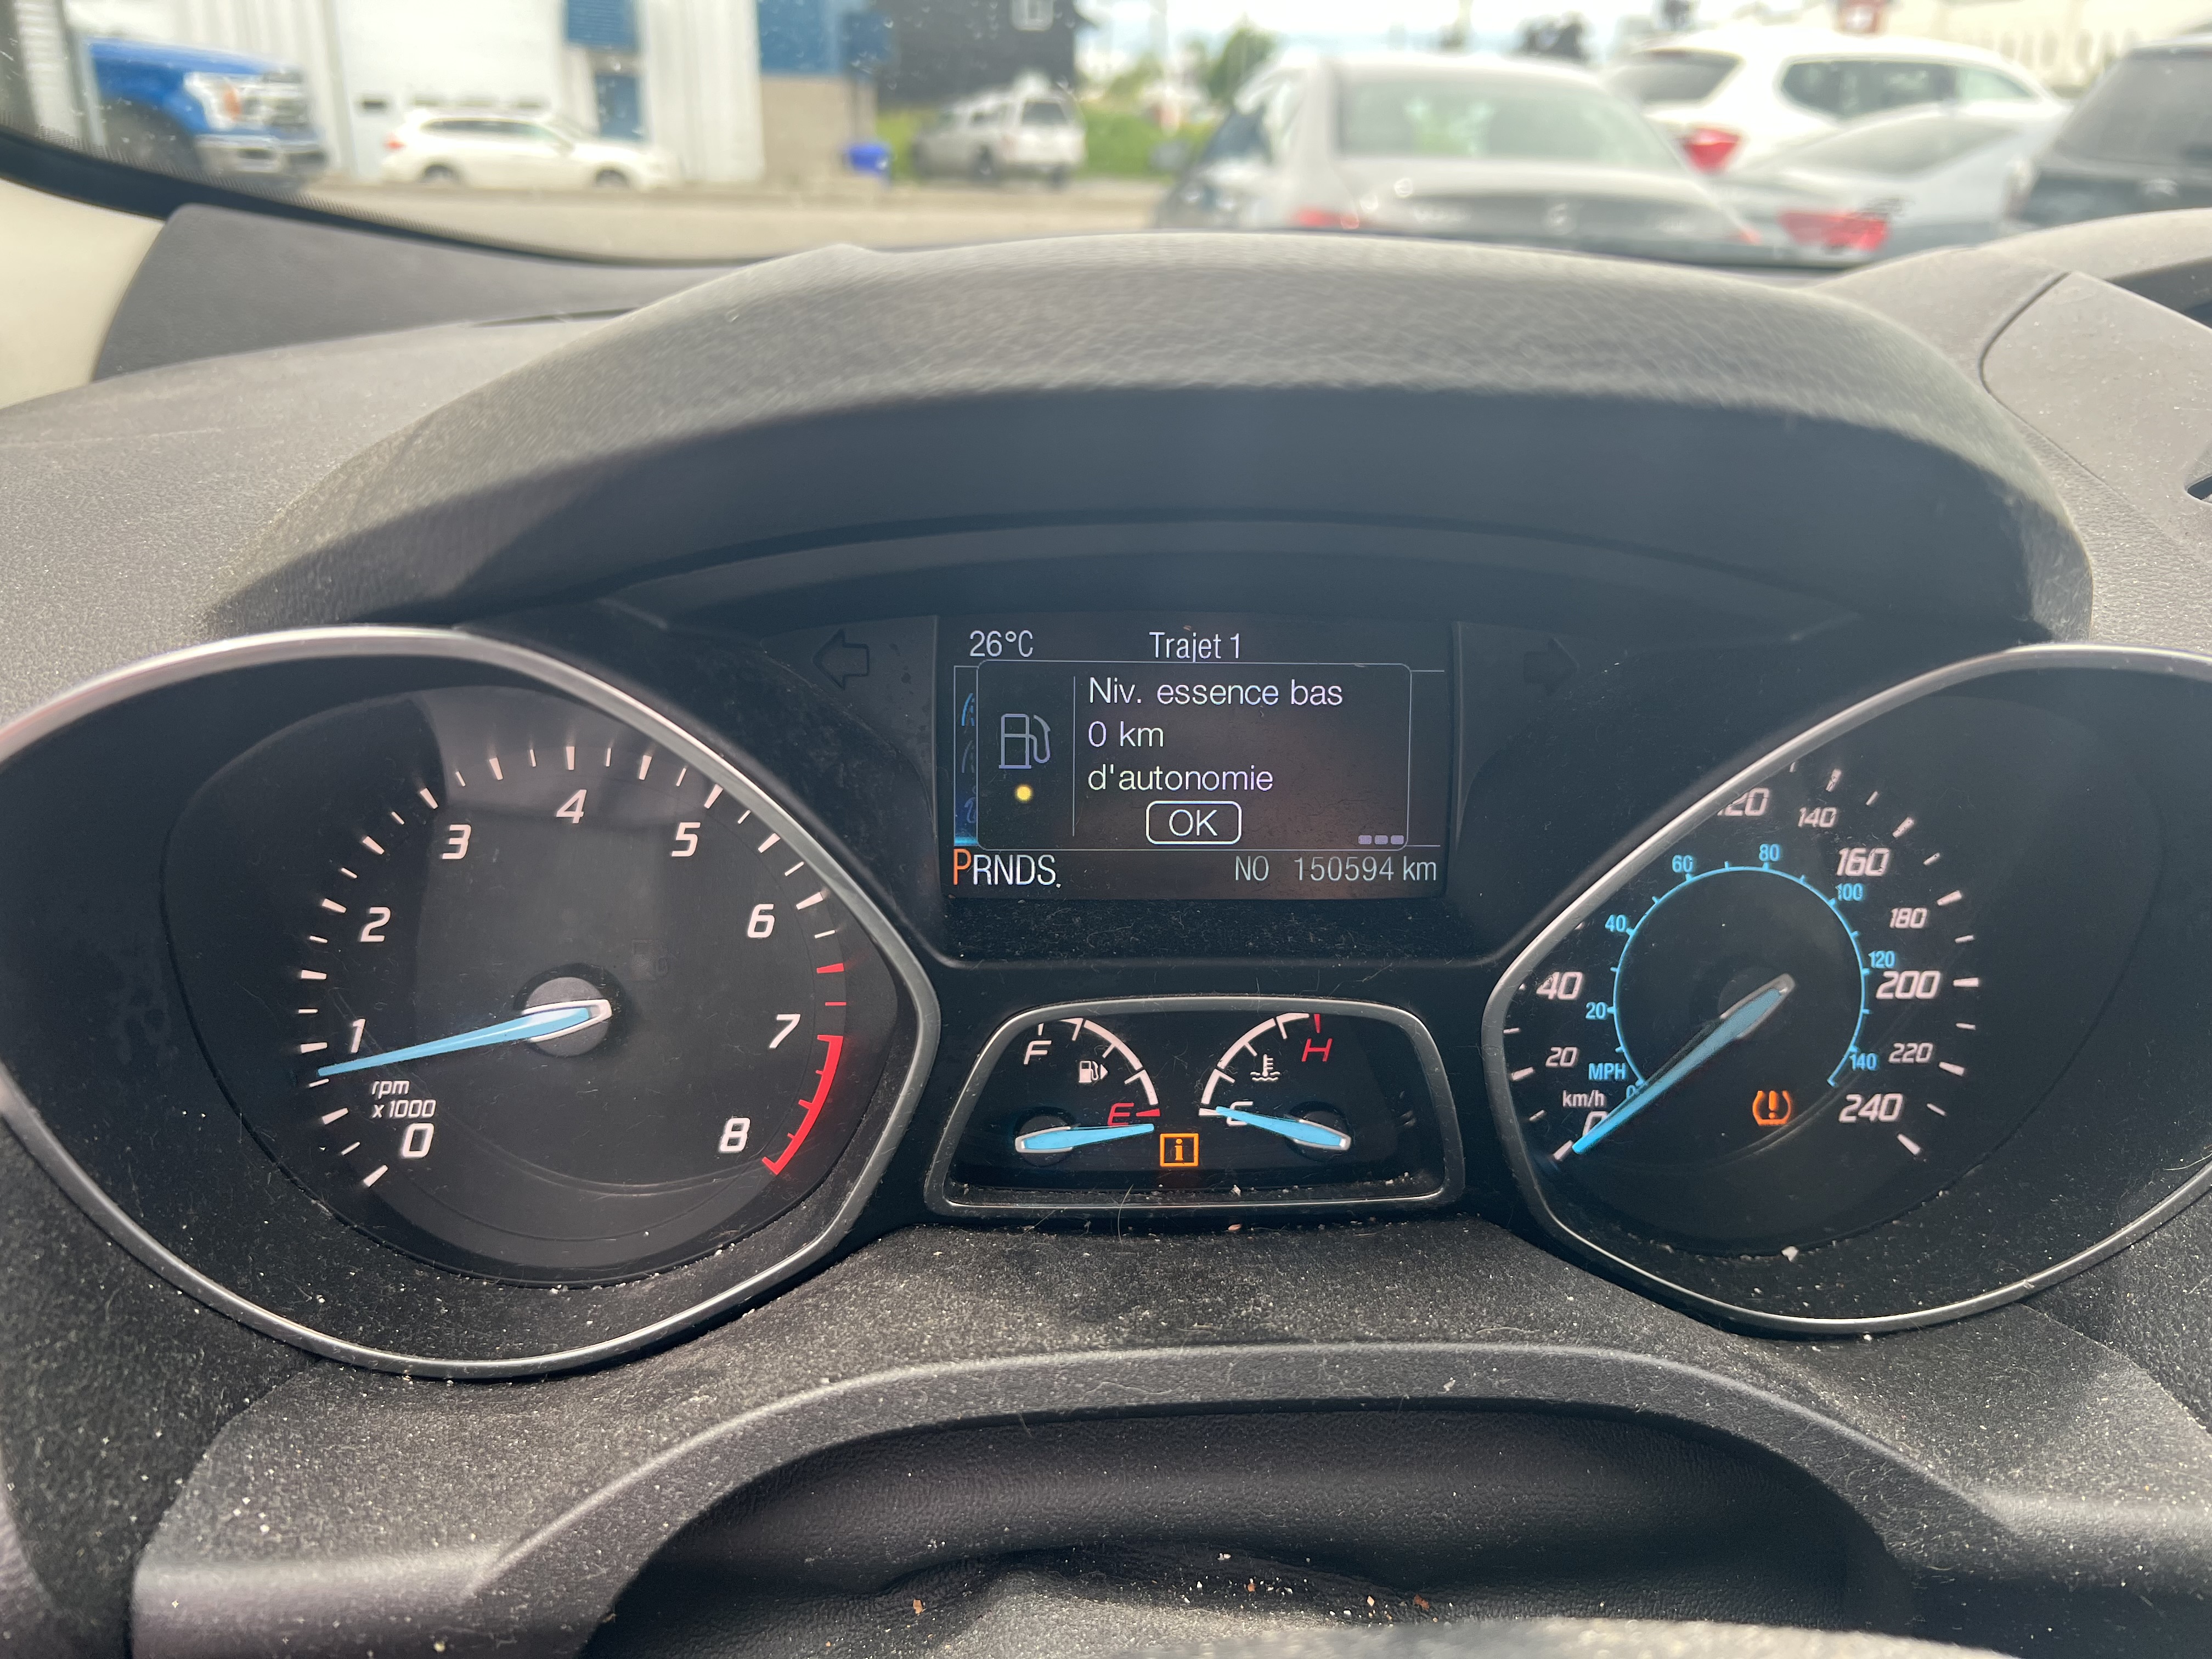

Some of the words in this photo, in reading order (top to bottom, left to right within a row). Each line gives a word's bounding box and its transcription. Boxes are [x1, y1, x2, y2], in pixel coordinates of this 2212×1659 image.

[969, 630, 1034, 658] 26°C
[1149, 631, 1223, 662] Trajet
[1229, 633, 1242, 659] 1
[1088, 676, 1142, 705] Niv.
[1156, 684, 1279, 706] essence
[1289, 679, 1344, 706] bas
[1088, 721, 1107, 747] 0
[1119, 720, 1165, 747] km
[1088, 764, 1274, 791] d'autonomie
[555, 789, 588, 824] 4
[1717, 788, 1770, 816] 20
[1168, 809, 1217, 837] OK
[1798, 806, 1837, 828] 140
[442, 825, 471, 859] 3
[671, 822, 701, 857] 5
[1759, 845, 1781, 861] 80
[1294, 855, 1394, 882] 150594
[1402, 856, 1437, 882] km
[1672, 856, 1694, 873] 60
[1836, 847, 1891, 877] 160
[1837, 884, 1863, 901] 100
[359, 907, 391, 942] 2
[747, 903, 775, 938] 6
[1604, 915, 1626, 933] 40
[1889, 908, 1928, 928] 180
[1869, 951, 1895, 968] 120
[1536, 972, 1583, 1000] 40
[1876, 970, 1941, 1000] 200
[1585, 1002, 1606, 1019] 20
[351, 1018, 366, 1052] 1
[770, 1014, 800, 1049] 7
[1024, 1040, 1052, 1065] F
[1301, 1038, 1333, 1062] H
[1545, 1047, 1578, 1066] 20
[1850, 1053, 1877, 1070] 140
[1888, 1043, 1933, 1063] 220
[1588, 1064, 1626, 1081] MPH
[371, 1080, 410, 1097] rpm
[1562, 1091, 1605, 1108] km/h
[1108, 1103, 1135, 1126] E
[1839, 1093, 1903, 1122] 240
[402, 1123, 434, 1158] 0
[720, 1118, 750, 1152] 8
